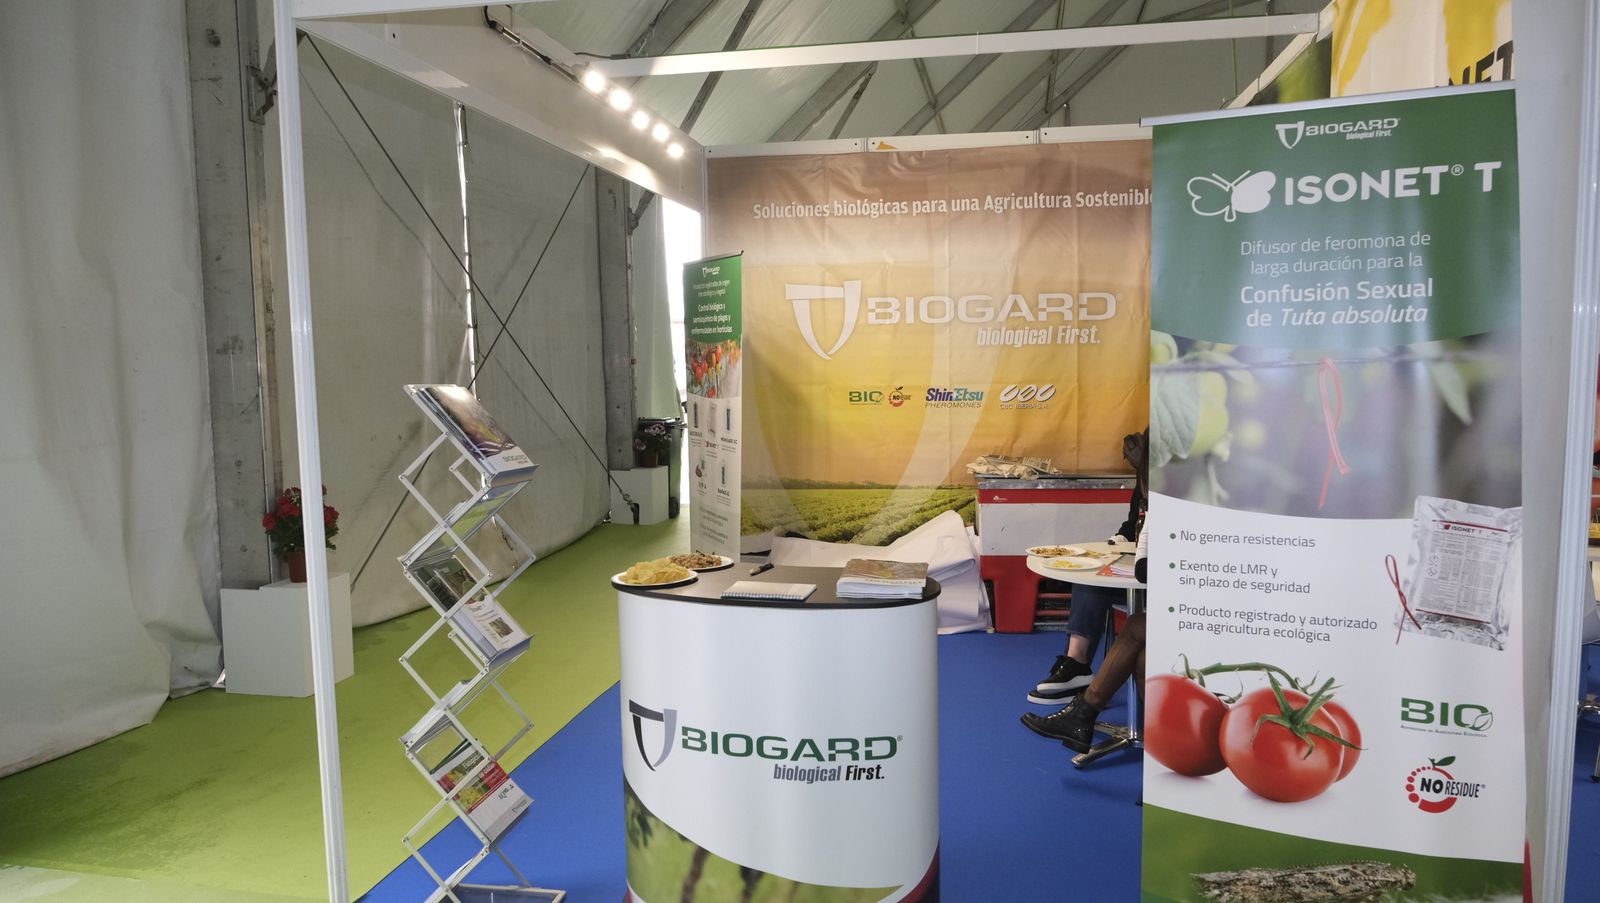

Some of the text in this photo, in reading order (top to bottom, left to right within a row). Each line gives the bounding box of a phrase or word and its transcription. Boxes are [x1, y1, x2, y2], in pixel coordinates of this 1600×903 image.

[1306, 118, 1399, 136] BIOGARD
[1474, 161, 1502, 192] T
[753, 188, 1152, 220] Soluciones biológicas para una Agricultura Sostenibl
[1241, 231, 1431, 255] Difusor de feromona de
[1251, 252, 1423, 278] larga duración para la
[1240, 278, 1434, 304] Confusión Sexual
[867, 292, 1117, 324] BIOGARD
[1246, 305, 1428, 327] de Tuta absoluta
[977, 325, 1100, 347] biological First.
[1180, 530, 1316, 548] No genera resistencias
[1180, 560, 1278, 578] Exento de LMR y
[1179, 575, 1311, 594] sin plazo de seguridad
[1179, 604, 1378, 630] Producto registrado y autorizado
[1178, 619, 1331, 643] para agricultura ecológica
[773, 763, 885, 784] biological First.
[1420, 777, 1444, 794] NO
